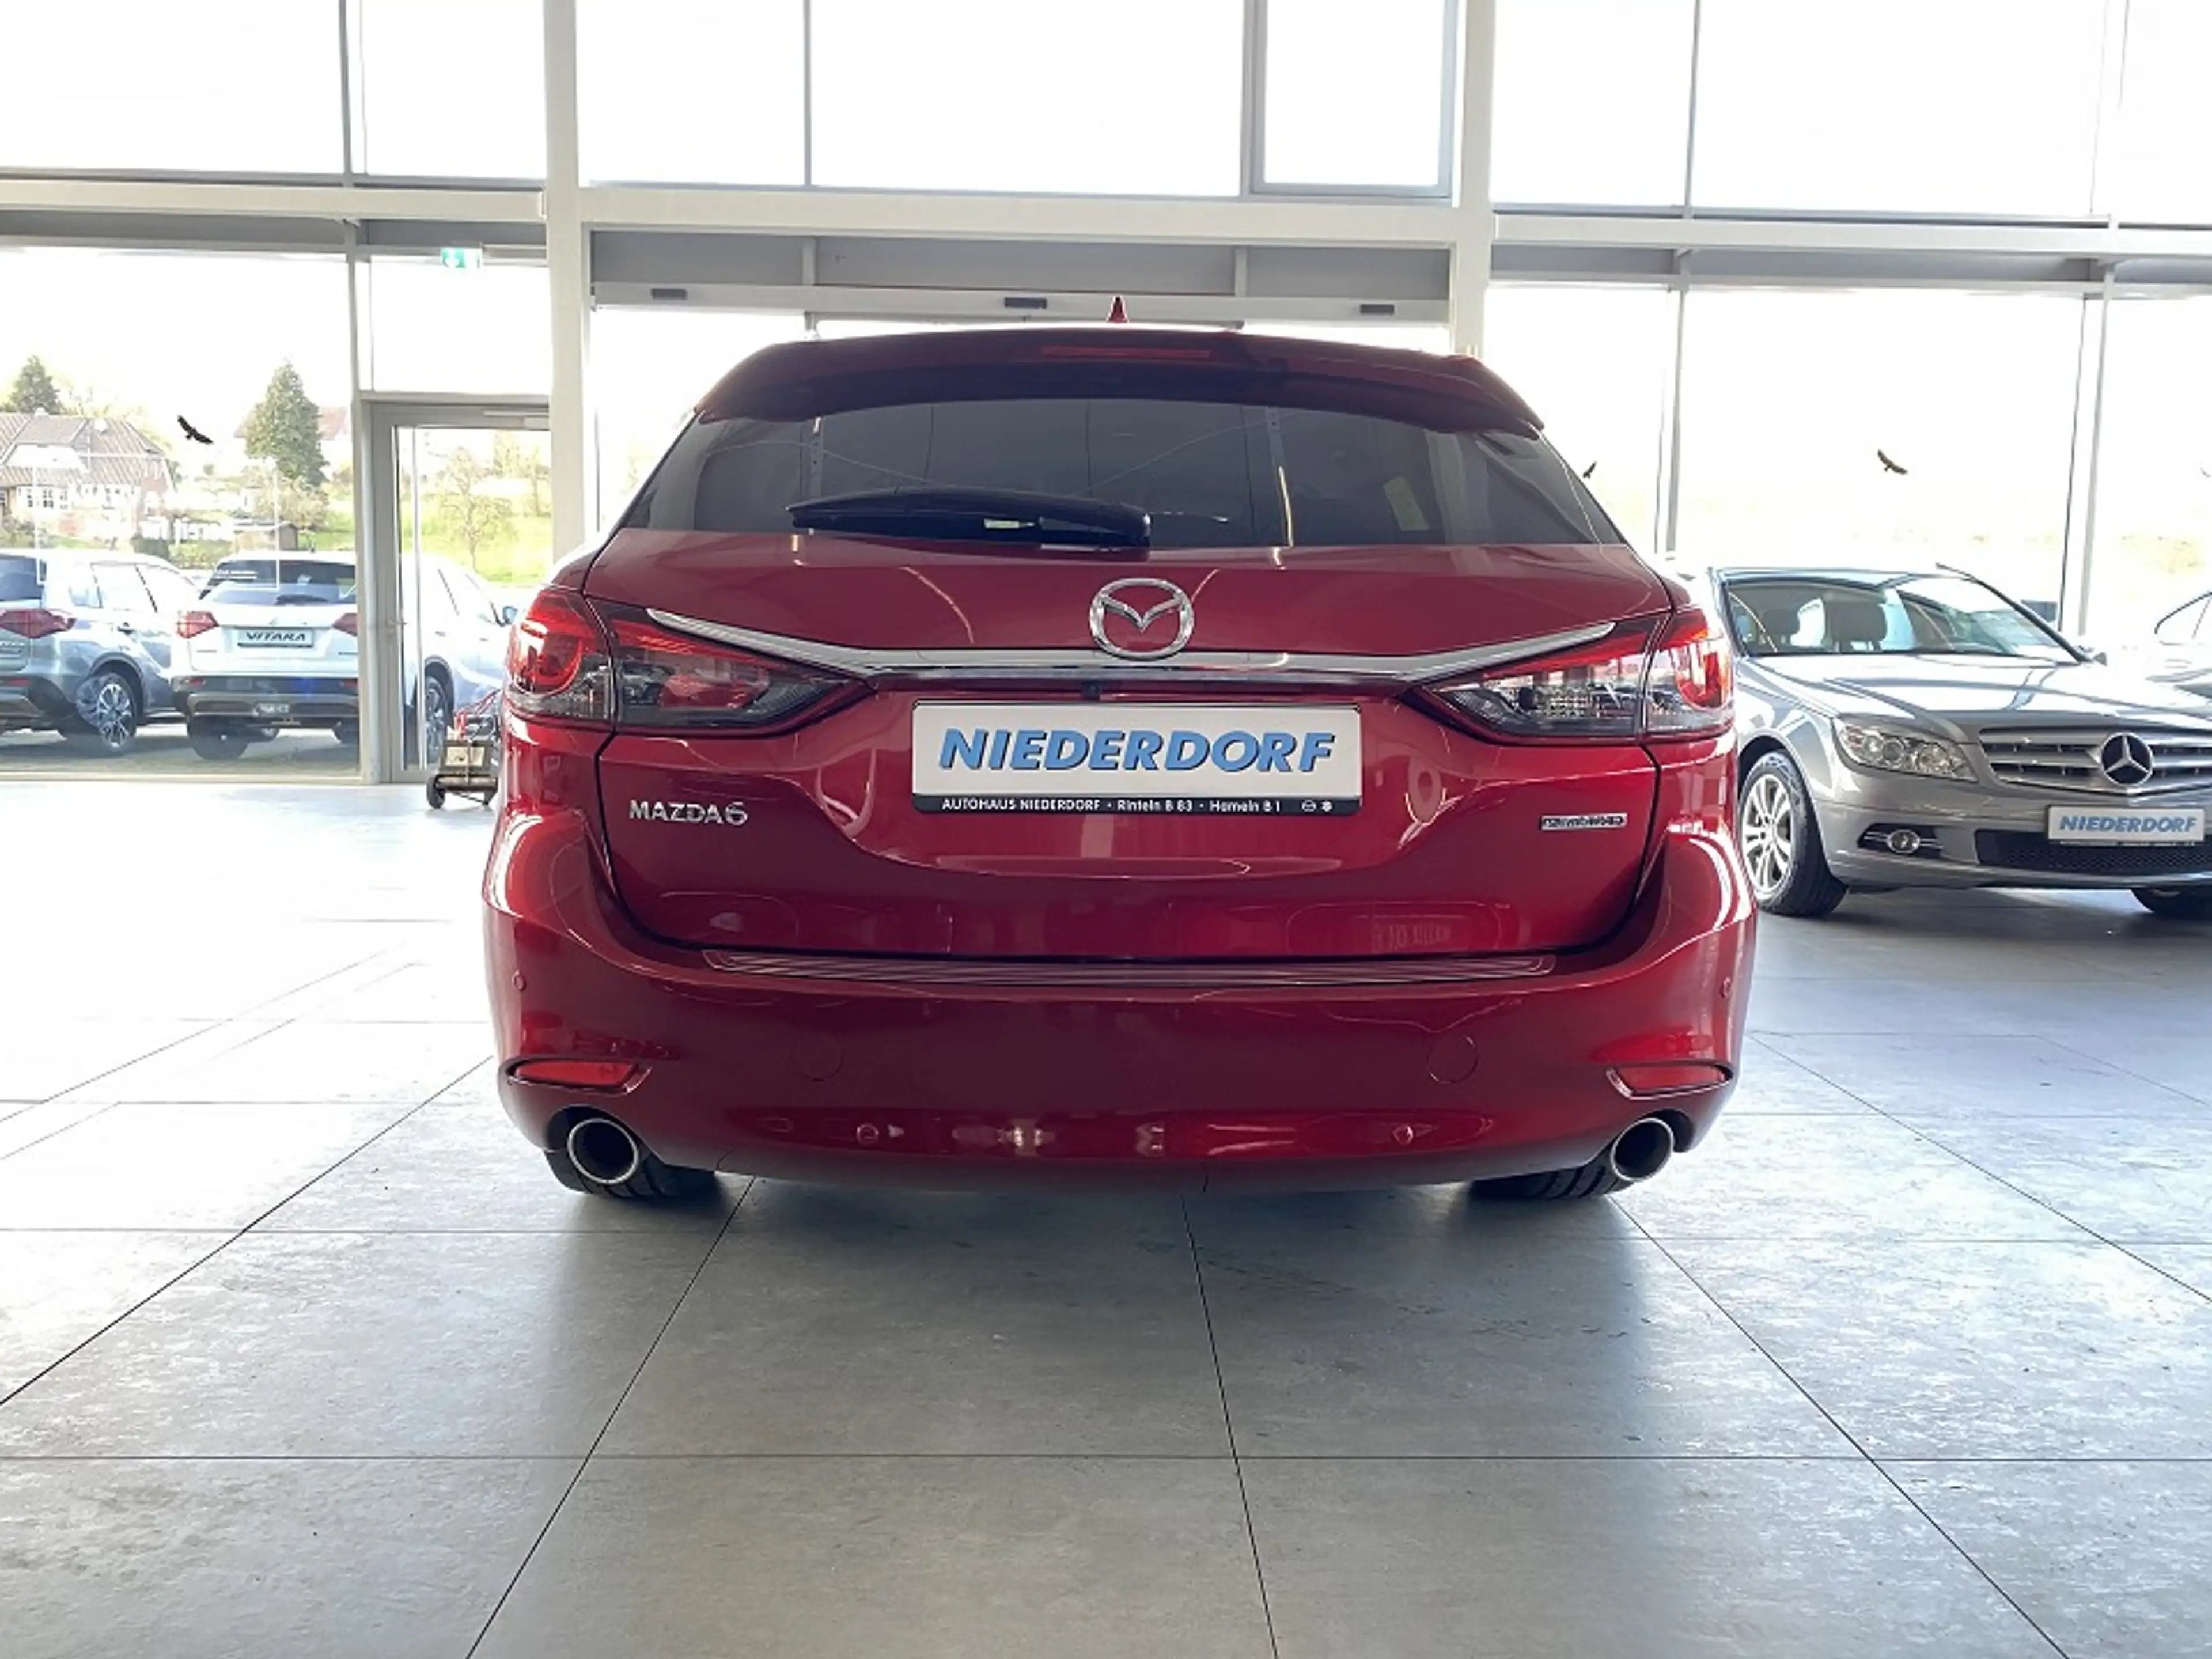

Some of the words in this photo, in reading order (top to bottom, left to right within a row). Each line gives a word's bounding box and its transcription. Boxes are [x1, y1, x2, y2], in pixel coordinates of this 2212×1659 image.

[247, 631, 305, 641] VITARA
[940, 729, 1335, 772] NIEDERDORF
[629, 799, 748, 825] MAZDA6
[942, 798, 1016, 810] AUTOHAUS
[1020, 798, 1100, 811] NIEDERDORF
[1117, 799, 1161, 812] Rinteln
[1209, 799, 1259, 812] Hameln
[2059, 815, 2197, 833] NIEDERDORF
